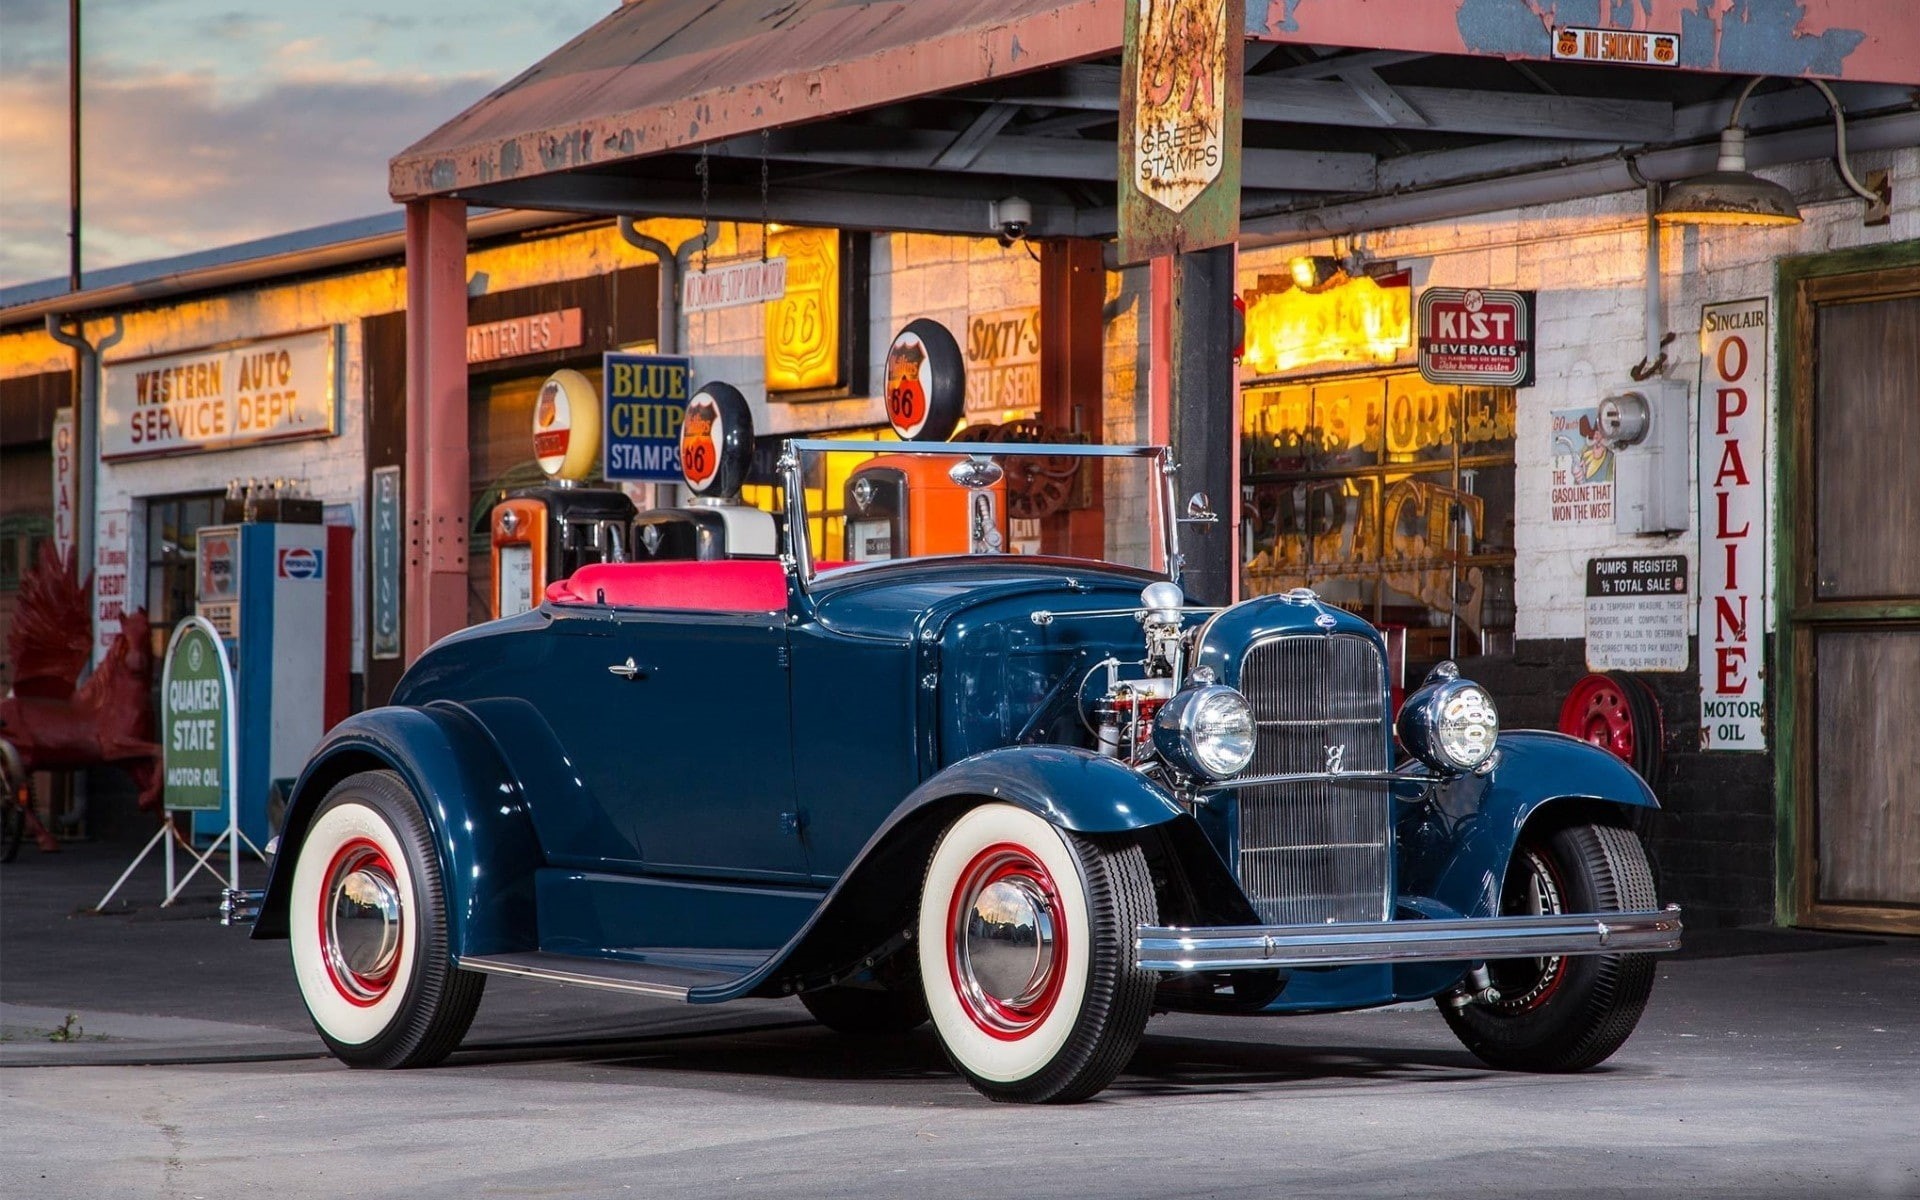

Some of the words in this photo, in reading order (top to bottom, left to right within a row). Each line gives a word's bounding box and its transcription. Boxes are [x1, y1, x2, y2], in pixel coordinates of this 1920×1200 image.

[1561, 43, 1574, 53] 66
[1584, 32, 1599, 58] NO
[1602, 32, 1649, 62] SMOKING
[1657, 49, 1670, 59] 66
[1141, 119, 1218, 154] GREEN
[1141, 145, 1218, 181] STAMPS
[782, 298, 817, 346] 66
[1438, 311, 1510, 340] KIST
[1430, 343, 1517, 356] BEVERAGES
[136, 360, 221, 406] WESTERN
[238, 350, 291, 392] AUTO
[1458, 361, 1477, 370] home
[612, 363, 685, 399] BLUE
[968, 369, 1002, 410] SELF
[131, 400, 225, 444] SERVICE
[238, 390, 304, 430] DEPT.
[892, 388, 914, 418] 66
[612, 403, 685, 438] CHIP
[1552, 416, 1566, 431] GO
[612, 443, 681, 472] STAMPS
[685, 445, 705, 473] 66
[1552, 470, 1566, 485] THE
[1552, 486, 1590, 503] GASOLINE
[1592, 484, 1611, 500] THAT
[1552, 505, 1572, 521] WON
[1573, 504, 1588, 519] THE
[1590, 503, 1611, 518] WEST
[1713, 335, 1750, 695] OPALINE
[1596, 561, 1627, 575] PUMPS
[1633, 559, 1678, 573] REGISTER
[1614, 579, 1643, 592] TOTAL
[1646, 578, 1671, 591] SALE
[170, 679, 220, 715] QUAKER
[1704, 701, 1762, 718] MOTOR
[173, 719, 216, 751] STATE
[1718, 724, 1746, 741] OIL
[167, 768, 201, 787] MOTOR
[203, 768, 220, 787] OIL
